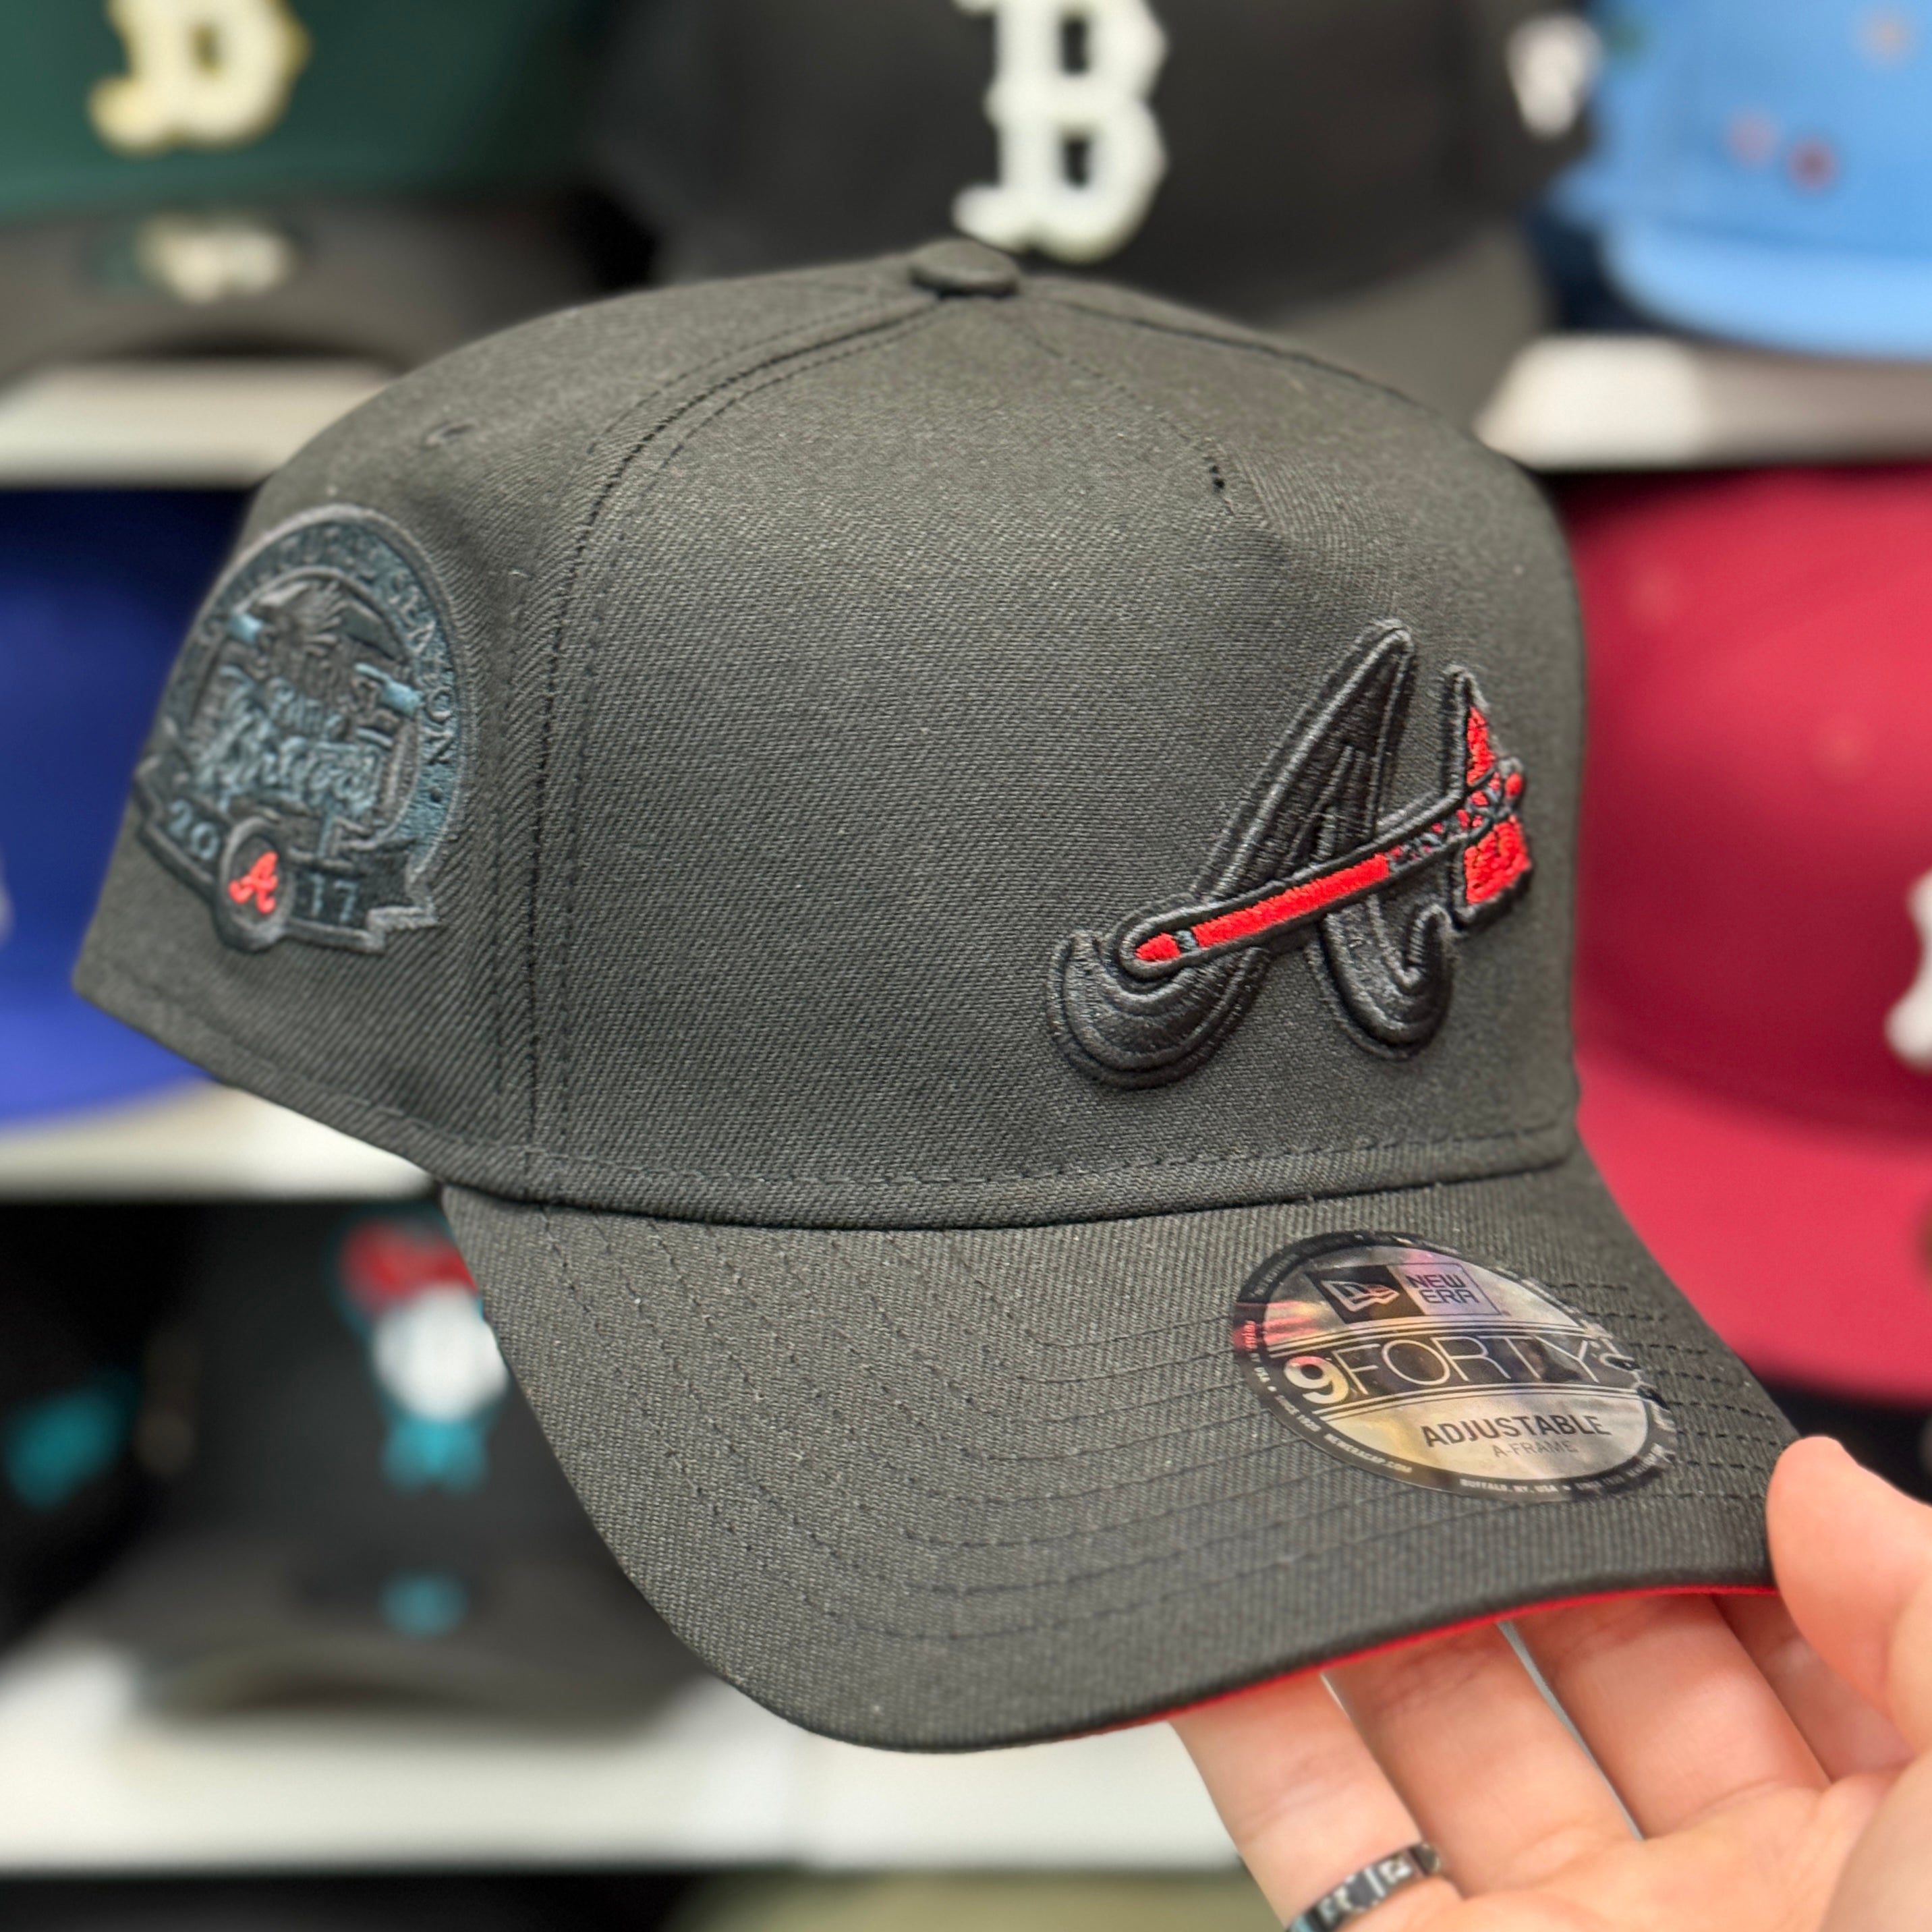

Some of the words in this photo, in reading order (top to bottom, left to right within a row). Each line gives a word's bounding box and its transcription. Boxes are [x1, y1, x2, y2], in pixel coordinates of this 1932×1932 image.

[953, 0, 1169, 262] B
[228, 850, 278, 913] A
[308, 876, 360, 922] 17
[1405, 1274, 1467, 1288] NEW
[1419, 1289, 1480, 1303] ERA
[1284, 1335, 1599, 1405] 9FORTY
[1421, 1414, 1612, 1448] ADJUSTABLE
[1492, 1440, 1579, 1458] A-FRAME
